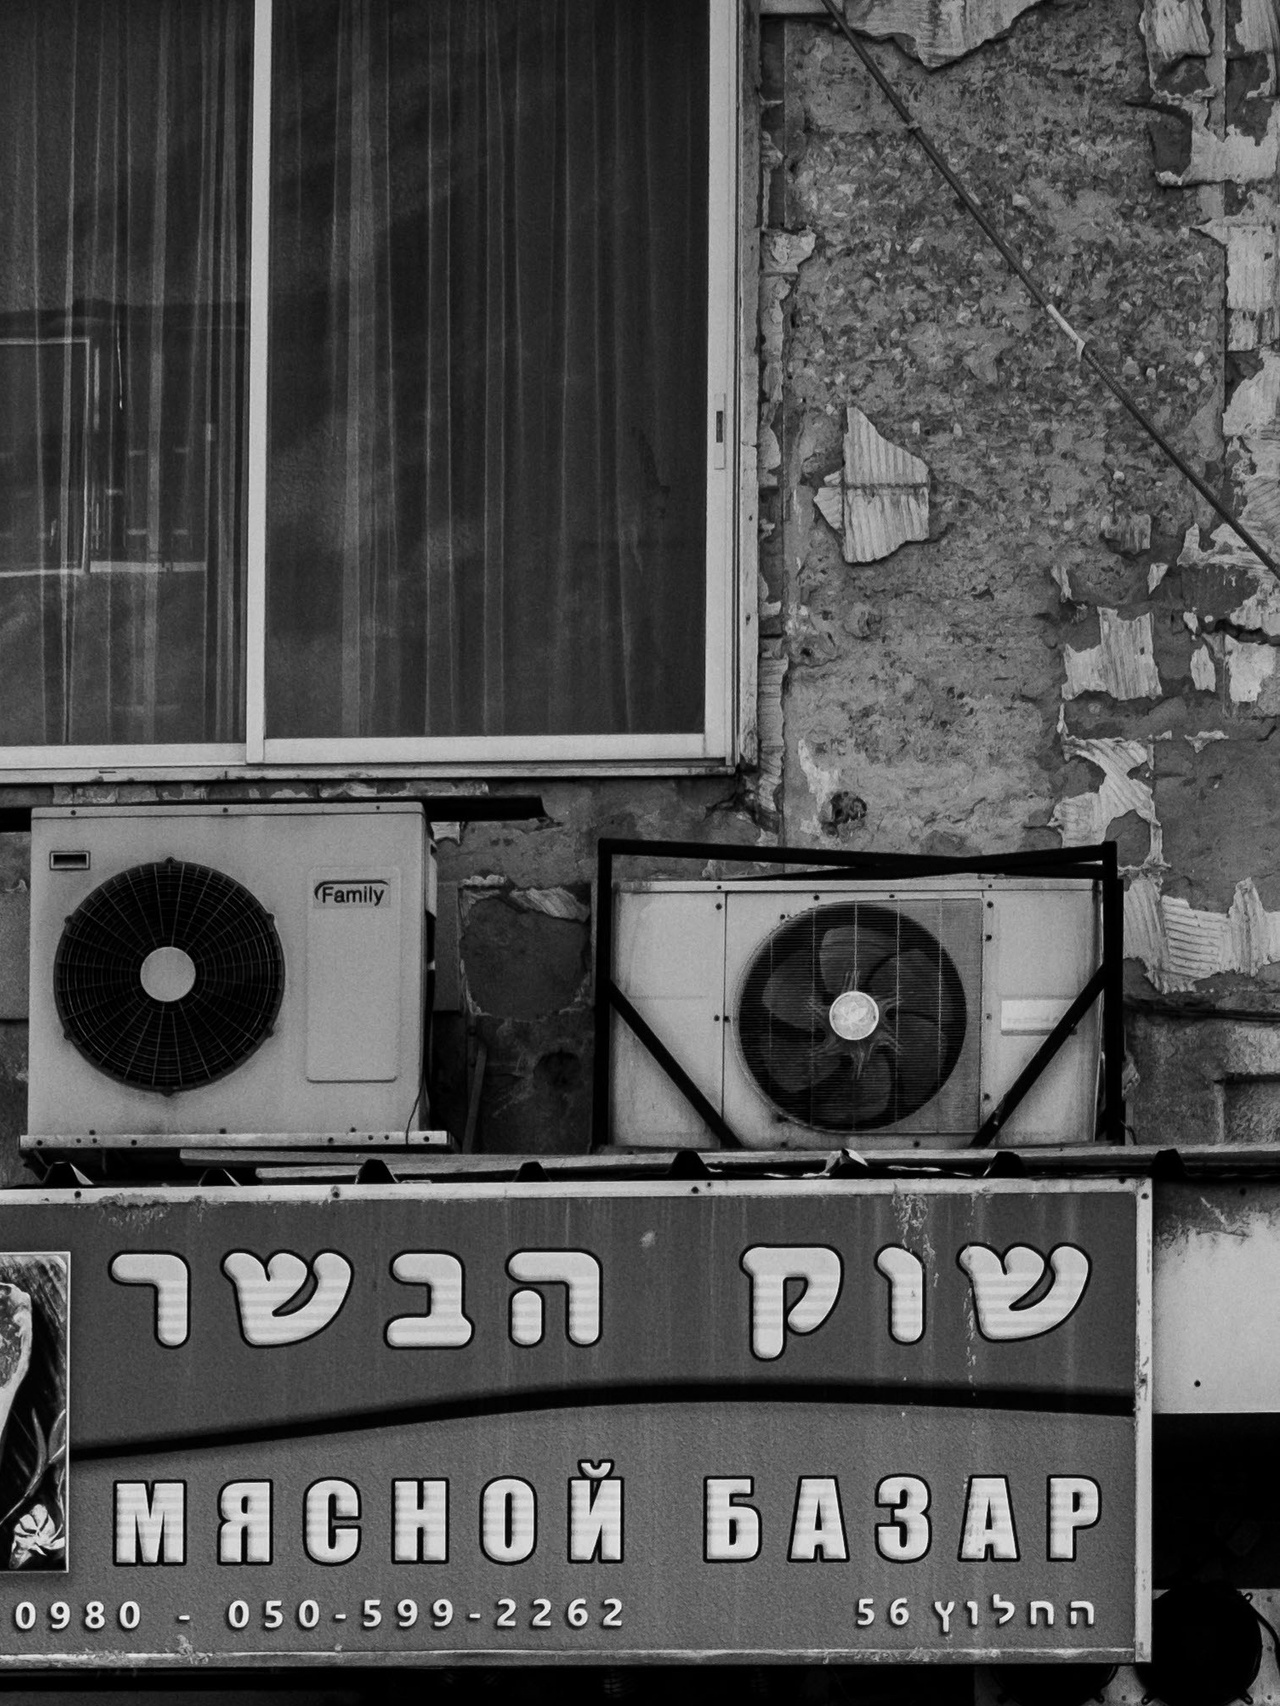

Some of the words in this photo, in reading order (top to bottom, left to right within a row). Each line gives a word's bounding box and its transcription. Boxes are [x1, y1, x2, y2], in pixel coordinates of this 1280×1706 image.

[322, 885, 385, 907] Family
[108, 1249, 603, 1349] הבשר
[741, 1242, 1091, 1362] שוק
[114, 1459, 626, 1566] МЯСНОЙ
[703, 1474, 1101, 1564] БАЗАР
[228, 1597, 623, 1629] 050-599-2262
[857, 1596, 910, 1626] 56
[934, 1593, 1096, 1634] החלוץ
